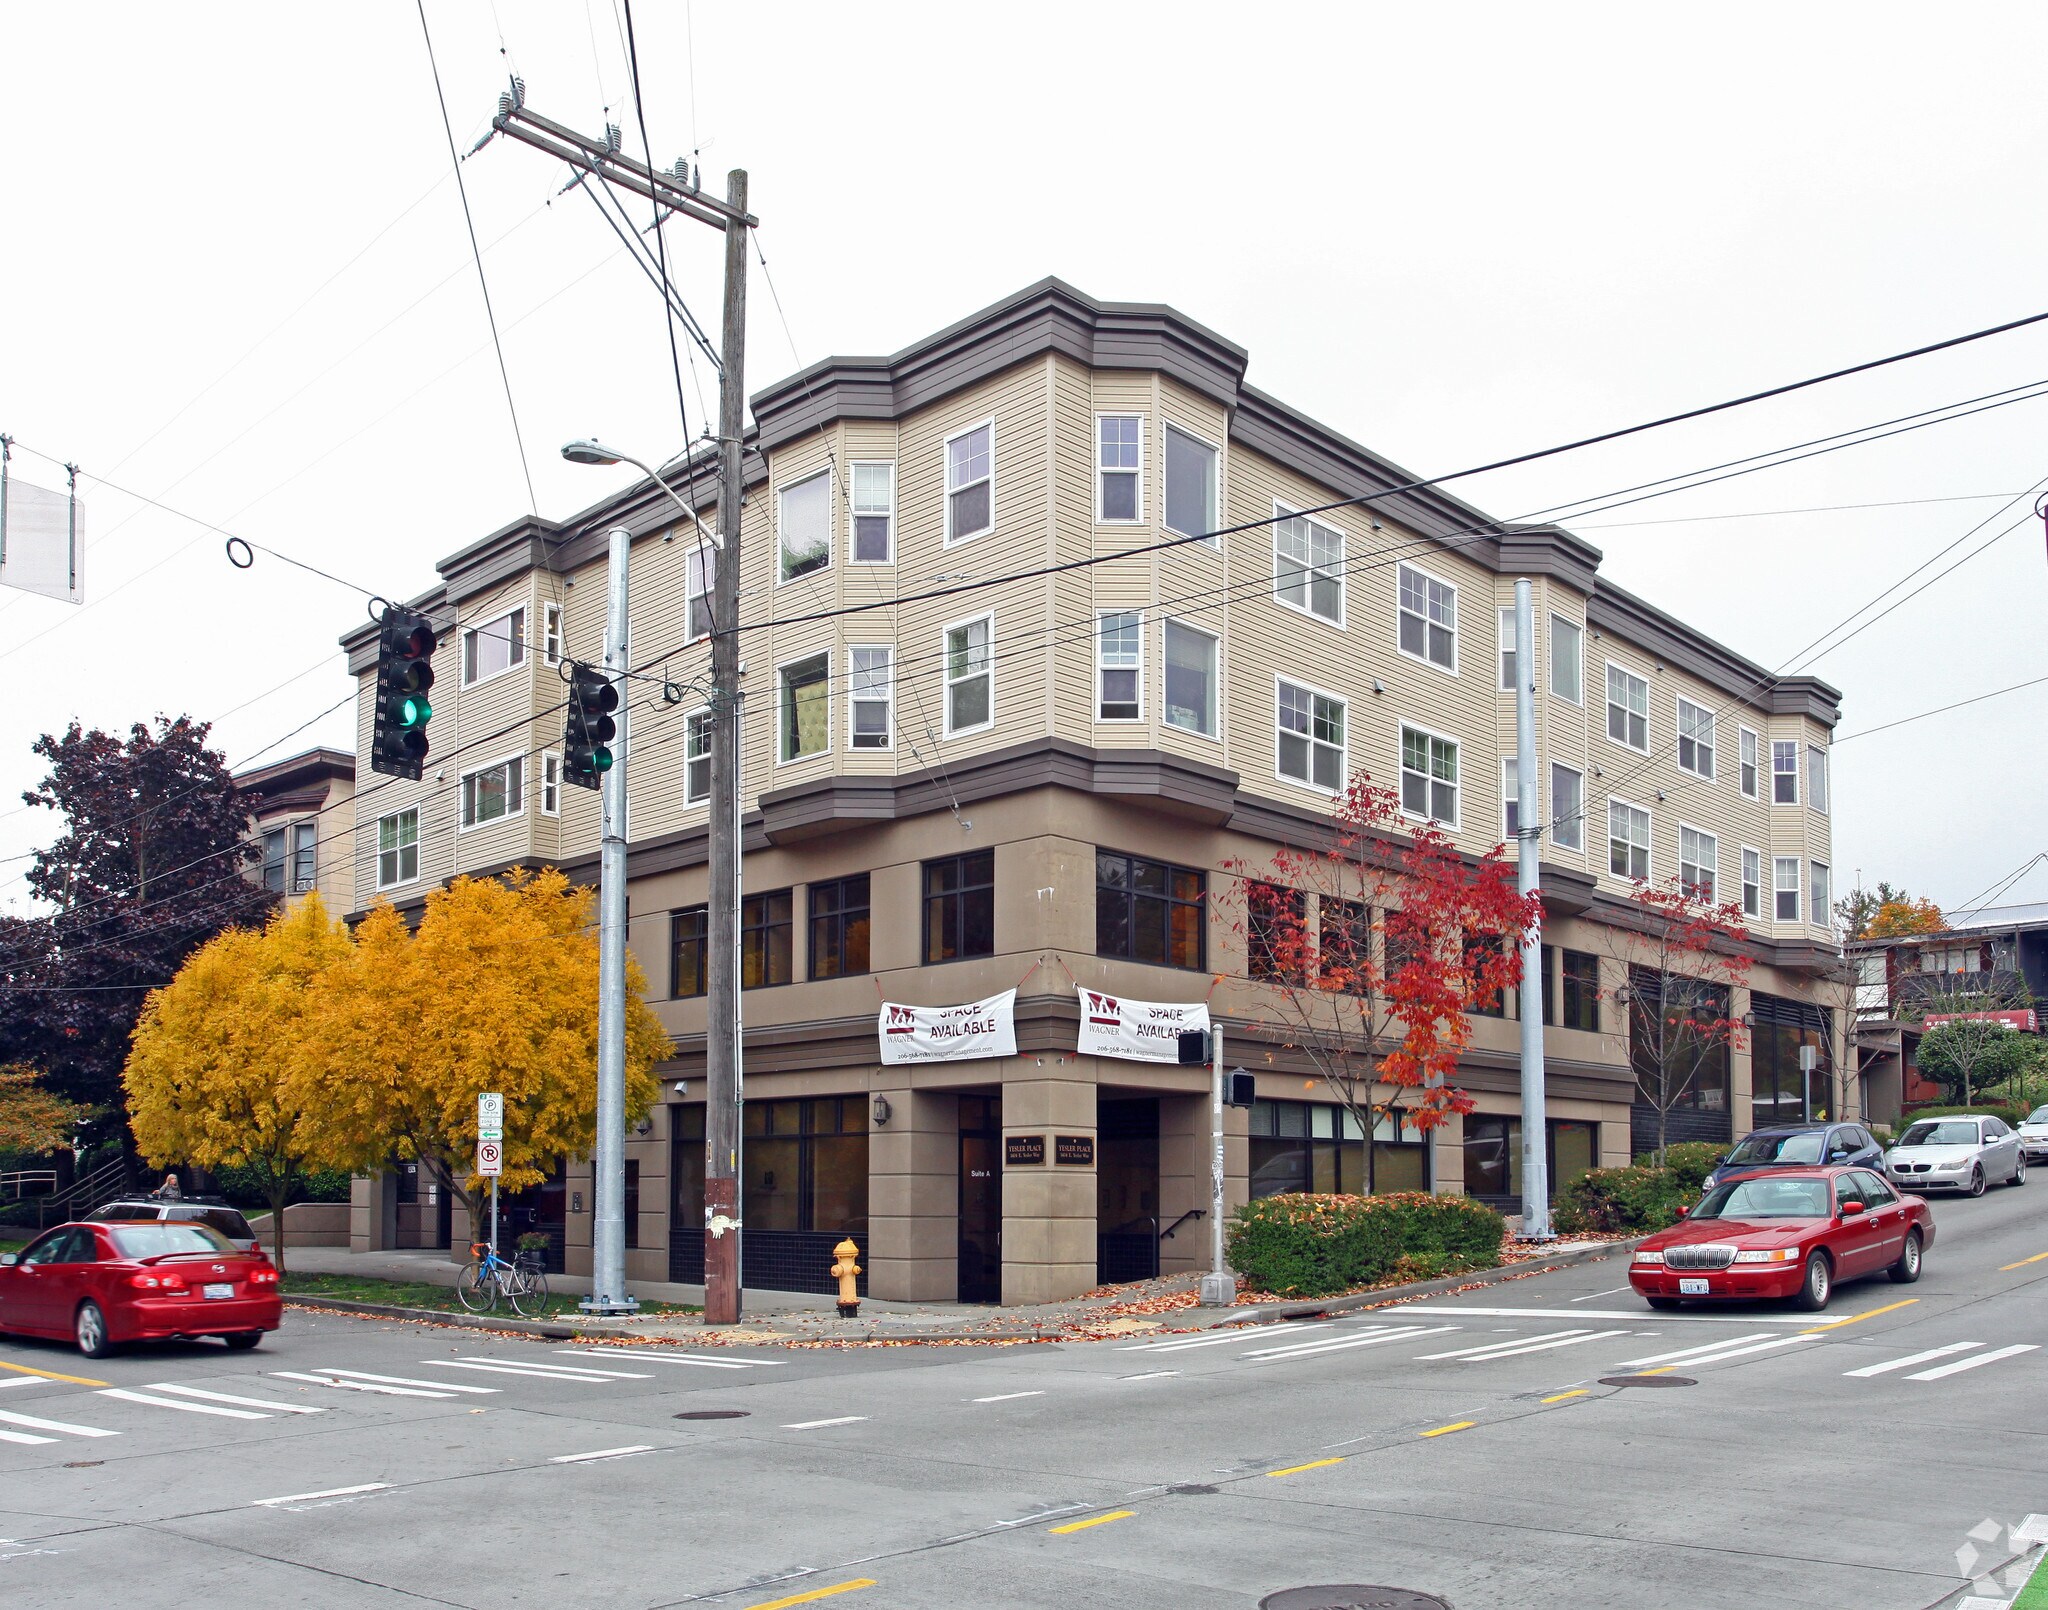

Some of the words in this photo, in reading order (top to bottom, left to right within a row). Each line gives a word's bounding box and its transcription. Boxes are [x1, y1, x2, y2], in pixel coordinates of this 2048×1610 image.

[1148, 1007, 1184, 1021] SPACE
[930, 1018, 996, 1038] AVAILABLE
[1089, 1024, 1120, 1036] WAGNER
[1137, 1024, 1195, 1040] AVAILAB
[887, 1034, 915, 1044] WAGNER
[1058, 1144, 1076, 1152] YESLER
